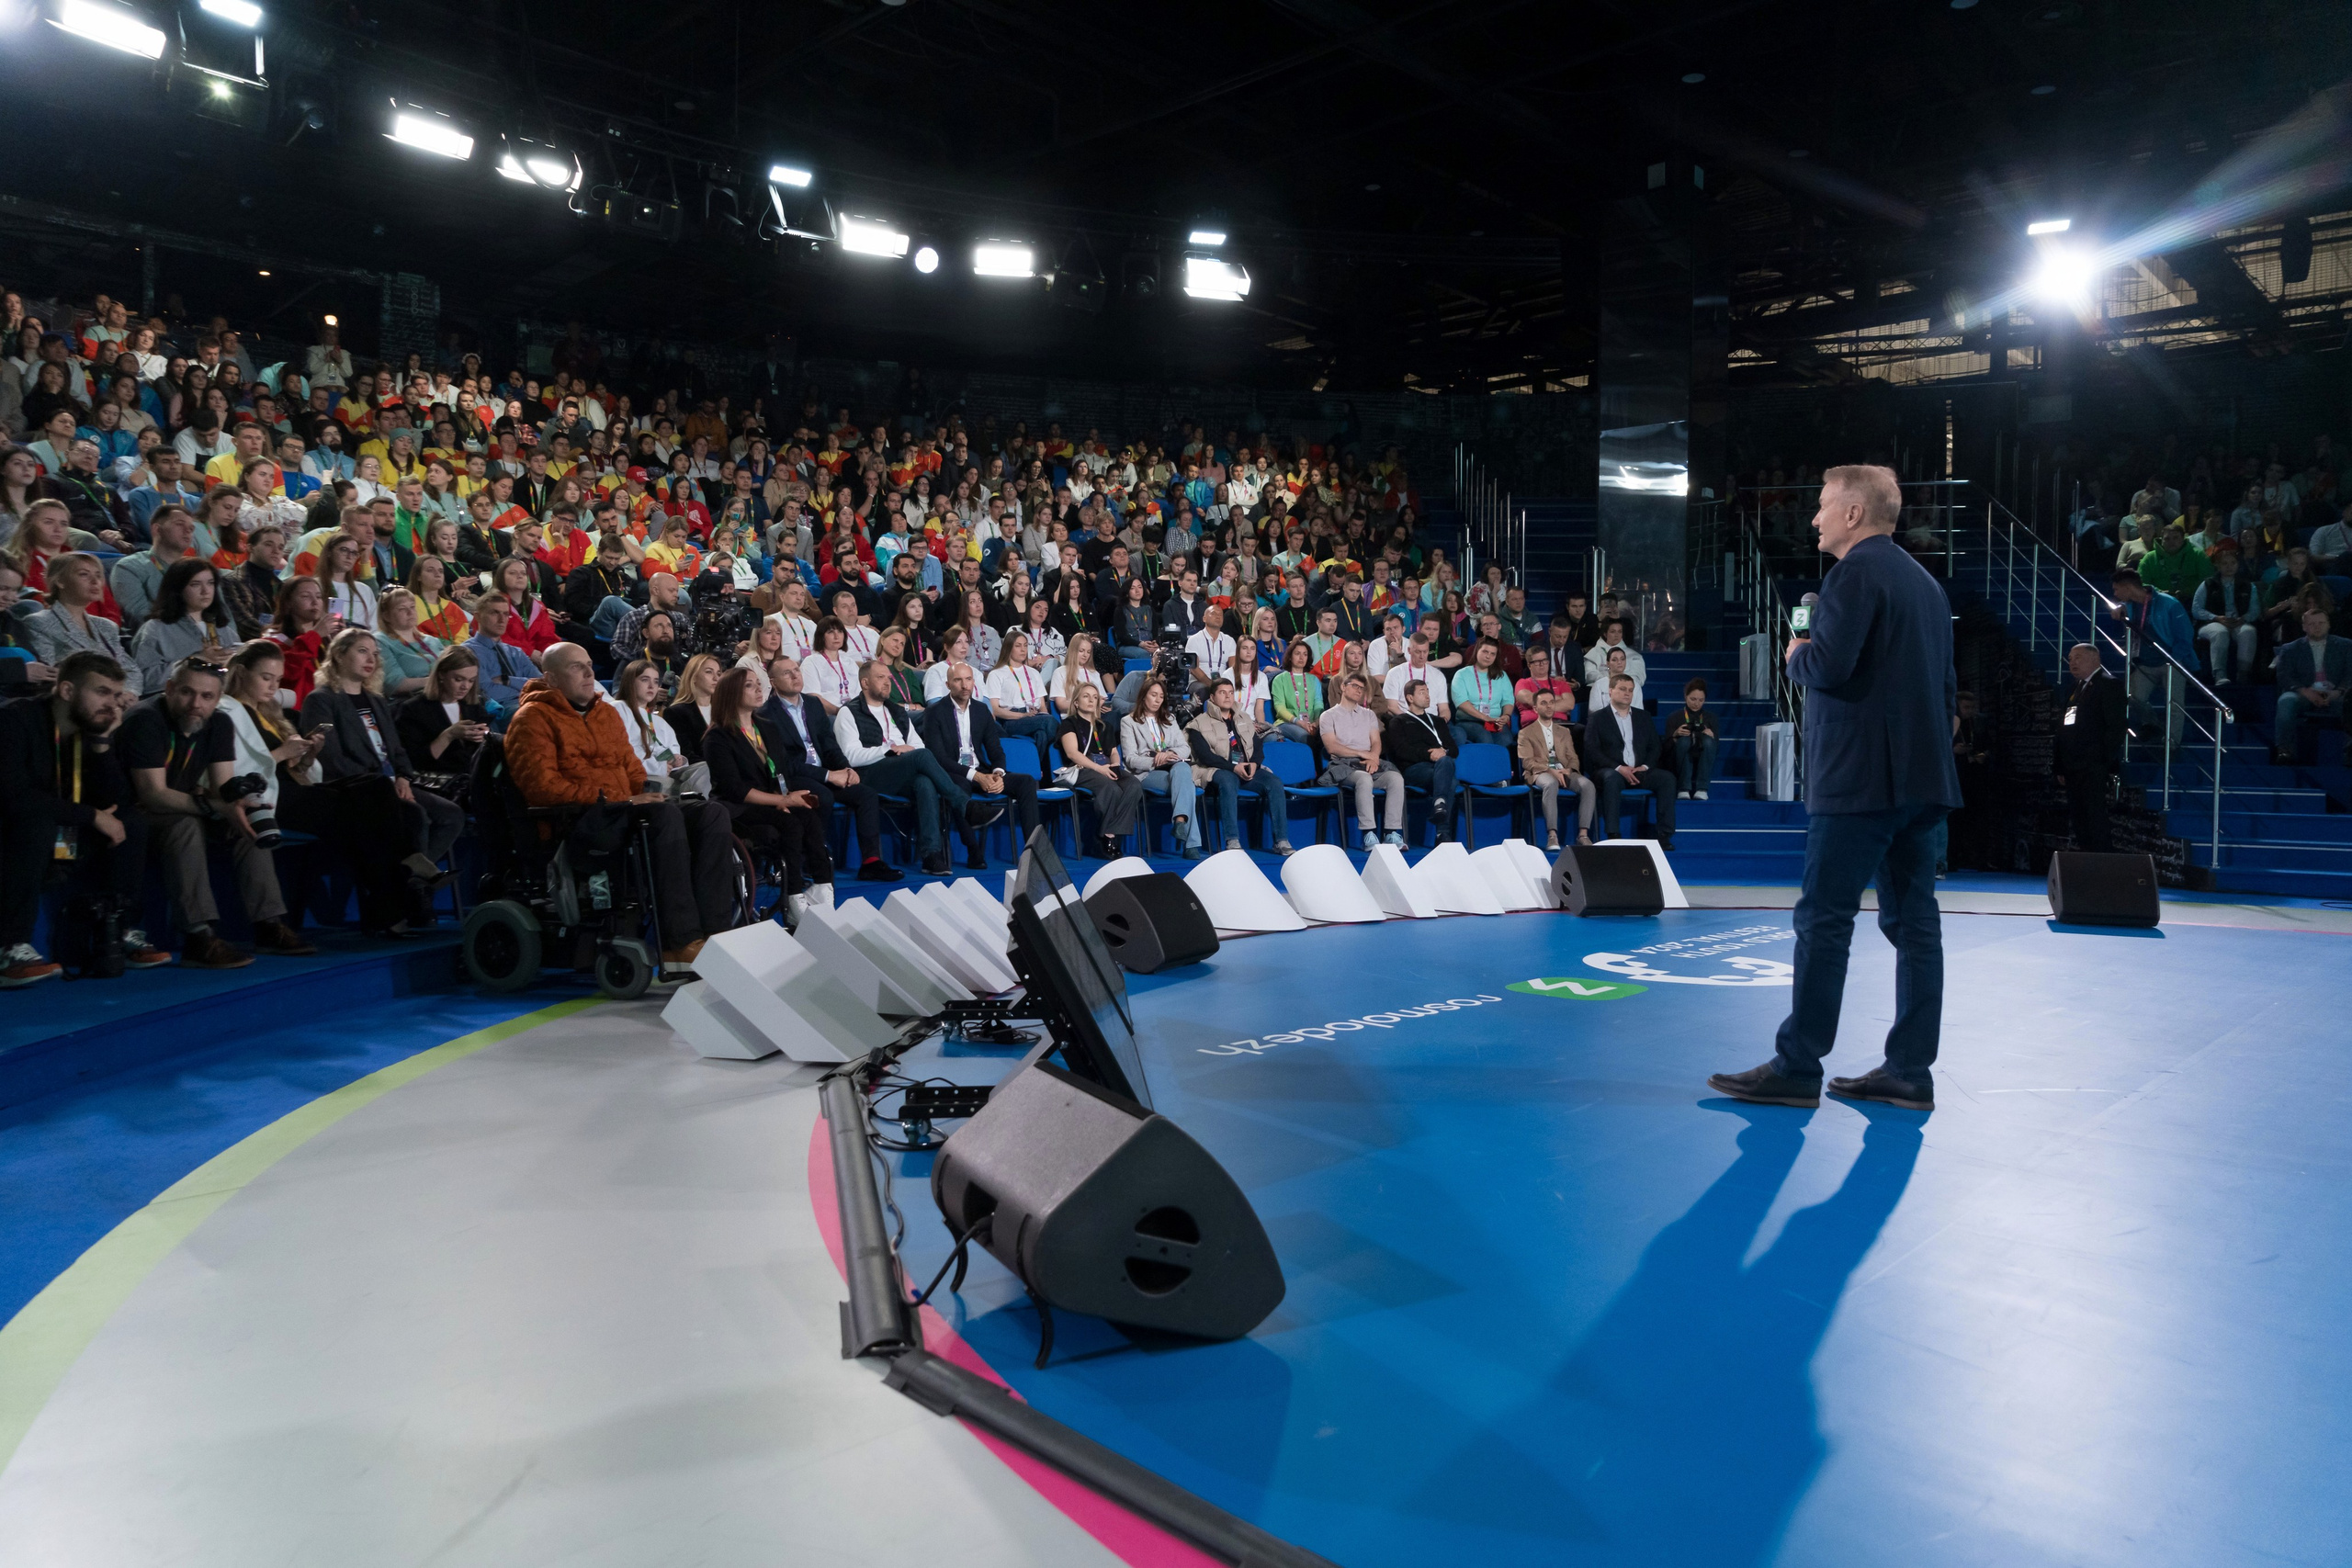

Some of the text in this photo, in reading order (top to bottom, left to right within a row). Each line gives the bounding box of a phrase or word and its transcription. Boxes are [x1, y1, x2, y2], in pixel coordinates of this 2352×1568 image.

[1630, 925, 1781, 954] FESTIVAL 2024
[1670, 930, 1796, 959] ORLD YOUTH
[1196, 994, 1503, 1055] rosmolodezh
